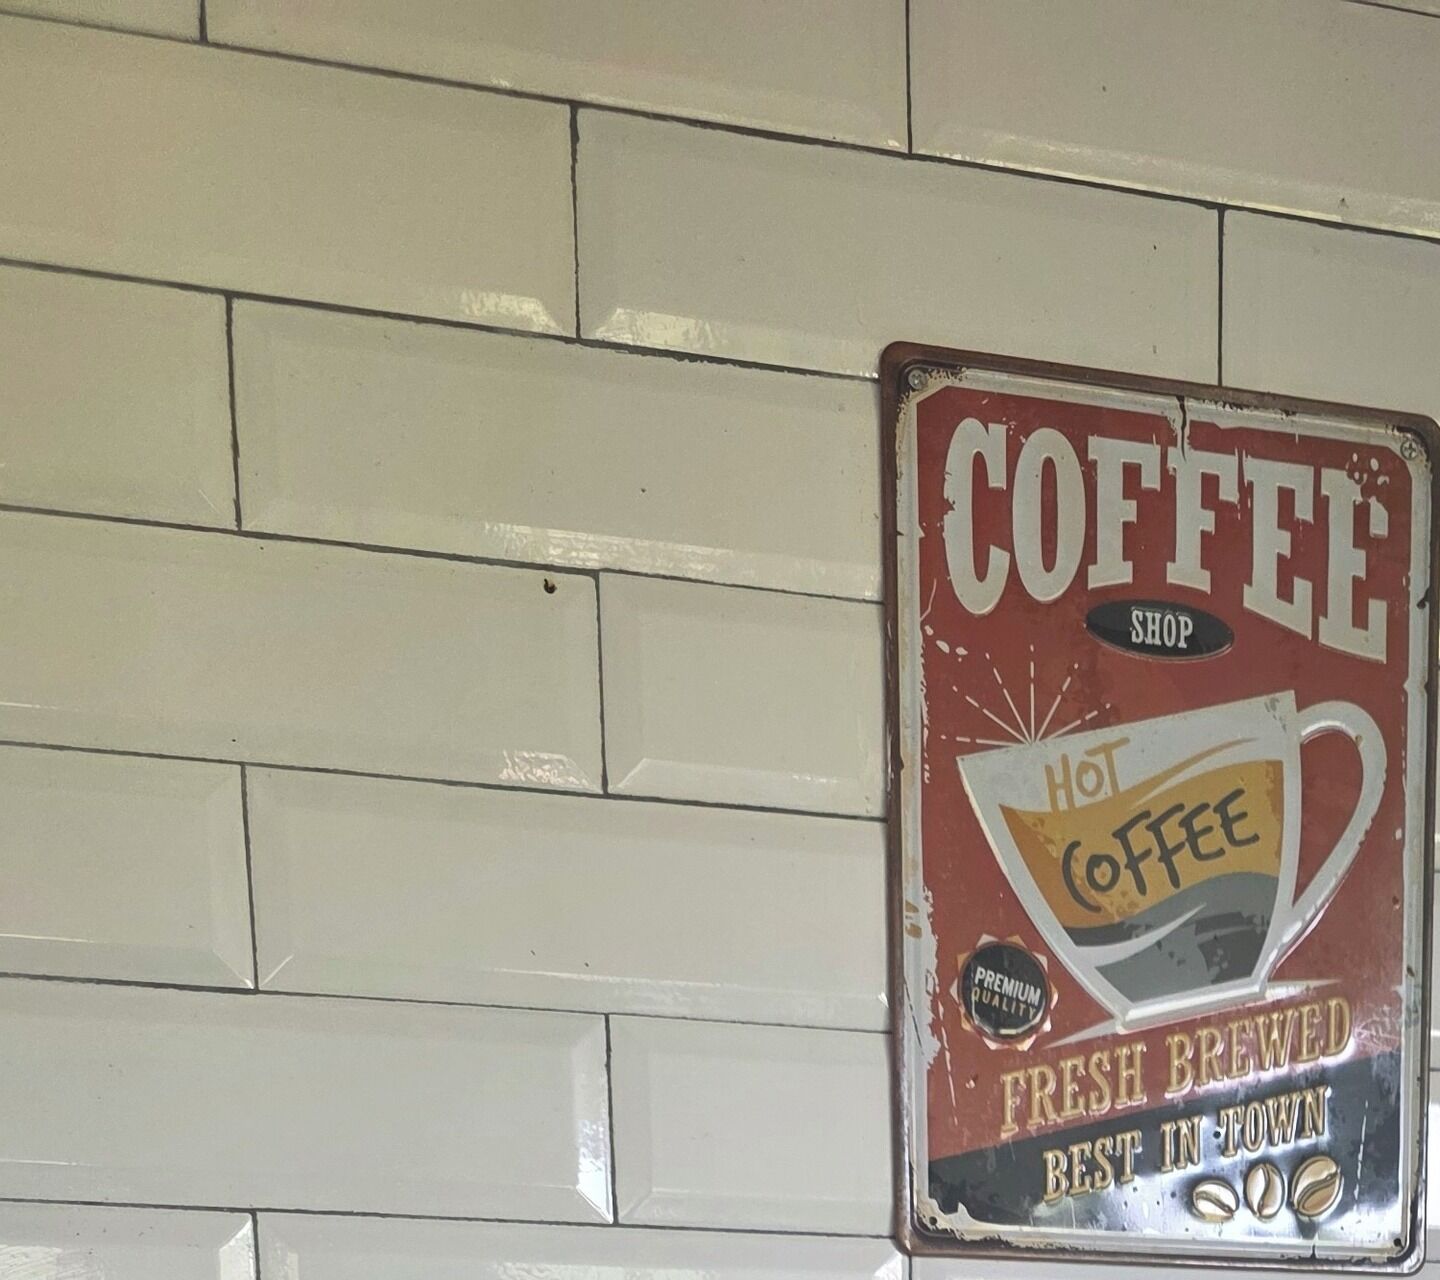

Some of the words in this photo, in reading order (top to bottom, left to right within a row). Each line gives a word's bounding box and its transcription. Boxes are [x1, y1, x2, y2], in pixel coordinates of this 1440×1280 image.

[943, 417, 1389, 664] COFFEE
[1131, 606, 1193, 649] SHOP
[1045, 737, 1131, 812] HOT
[972, 986, 1037, 1020] QUALITY
[974, 966, 1041, 1006] PREMIUM
[1000, 1041, 1147, 1137] FRESH
[1165, 997, 1353, 1098] BREWED
[1042, 1129, 1142, 1204] BEST
[1160, 1114, 1205, 1174] IN
[1219, 1086, 1332, 1158] TOWN
